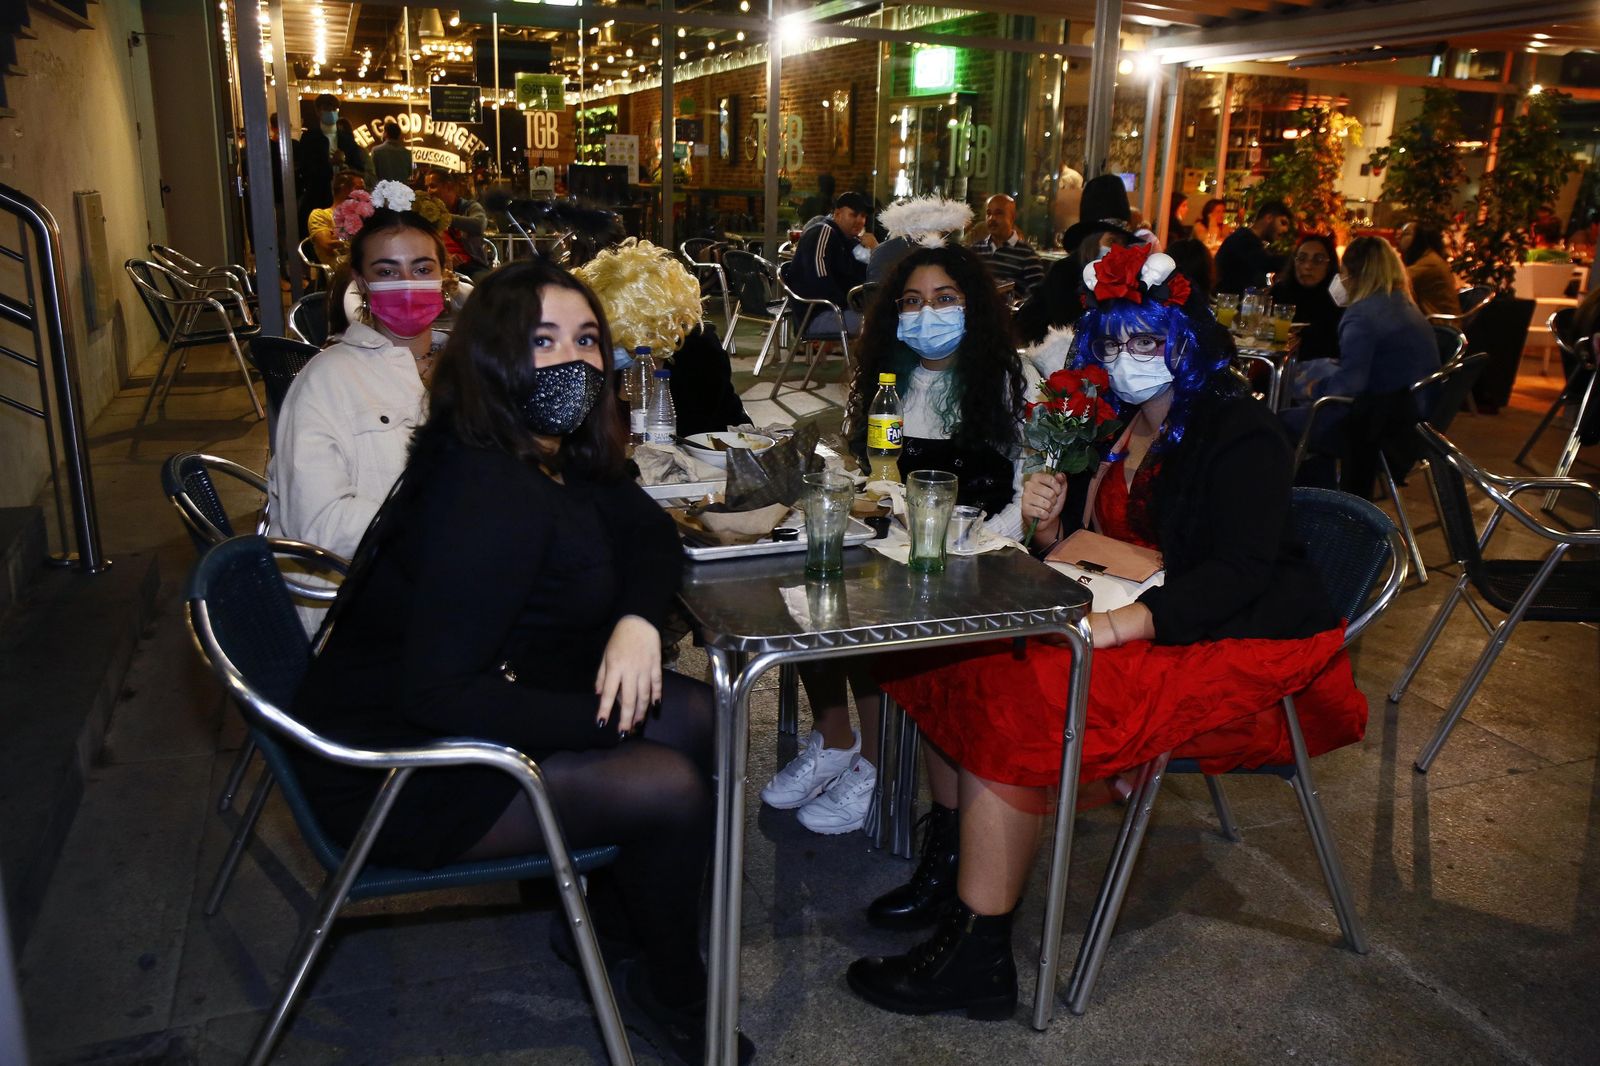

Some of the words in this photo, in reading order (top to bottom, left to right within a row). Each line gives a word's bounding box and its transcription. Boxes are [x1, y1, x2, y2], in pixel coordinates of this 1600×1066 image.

[353, 124, 375, 149] HE
[522, 111, 559, 150] TGB
[413, 149, 451, 166] GUESAS
[947, 123, 993, 178] TGB
[887, 428, 903, 441] FAN
